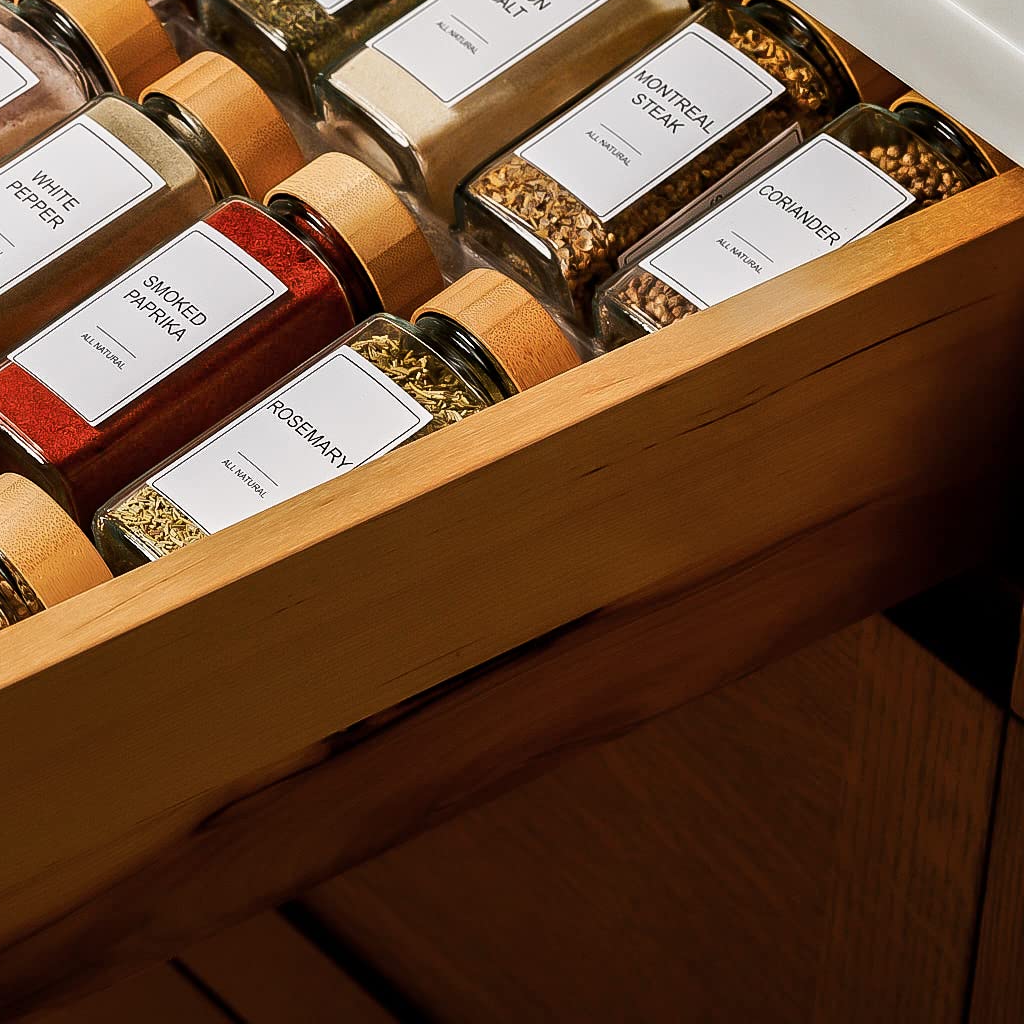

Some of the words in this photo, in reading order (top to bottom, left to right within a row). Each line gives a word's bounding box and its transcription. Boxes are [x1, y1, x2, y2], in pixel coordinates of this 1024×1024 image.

[436, 21, 450, 33] ALL
[447, 29, 478, 56] NATURAL
[631, 93, 685, 135] STEAK
[634, 70, 719, 135] MONTREAL
[585, 130, 600, 142] ALL
[598, 139, 632, 167] NATURAL
[6, 180, 65, 230] PEPPER
[31, 170, 80, 212] WHITE
[758, 184, 841, 247] CORIANDER
[715, 237, 731, 250] ALL
[729, 246, 763, 274] NATURAL
[123, 289, 187, 342] PAPRIKA
[143, 275, 207, 326] SMOKED
[80, 332, 95, 346] ALL
[93, 341, 125, 370] NATURAL
[266, 400, 354, 471] ROSEMARY
[221, 458, 236, 472] ALL
[234, 467, 268, 498] NATURAL
